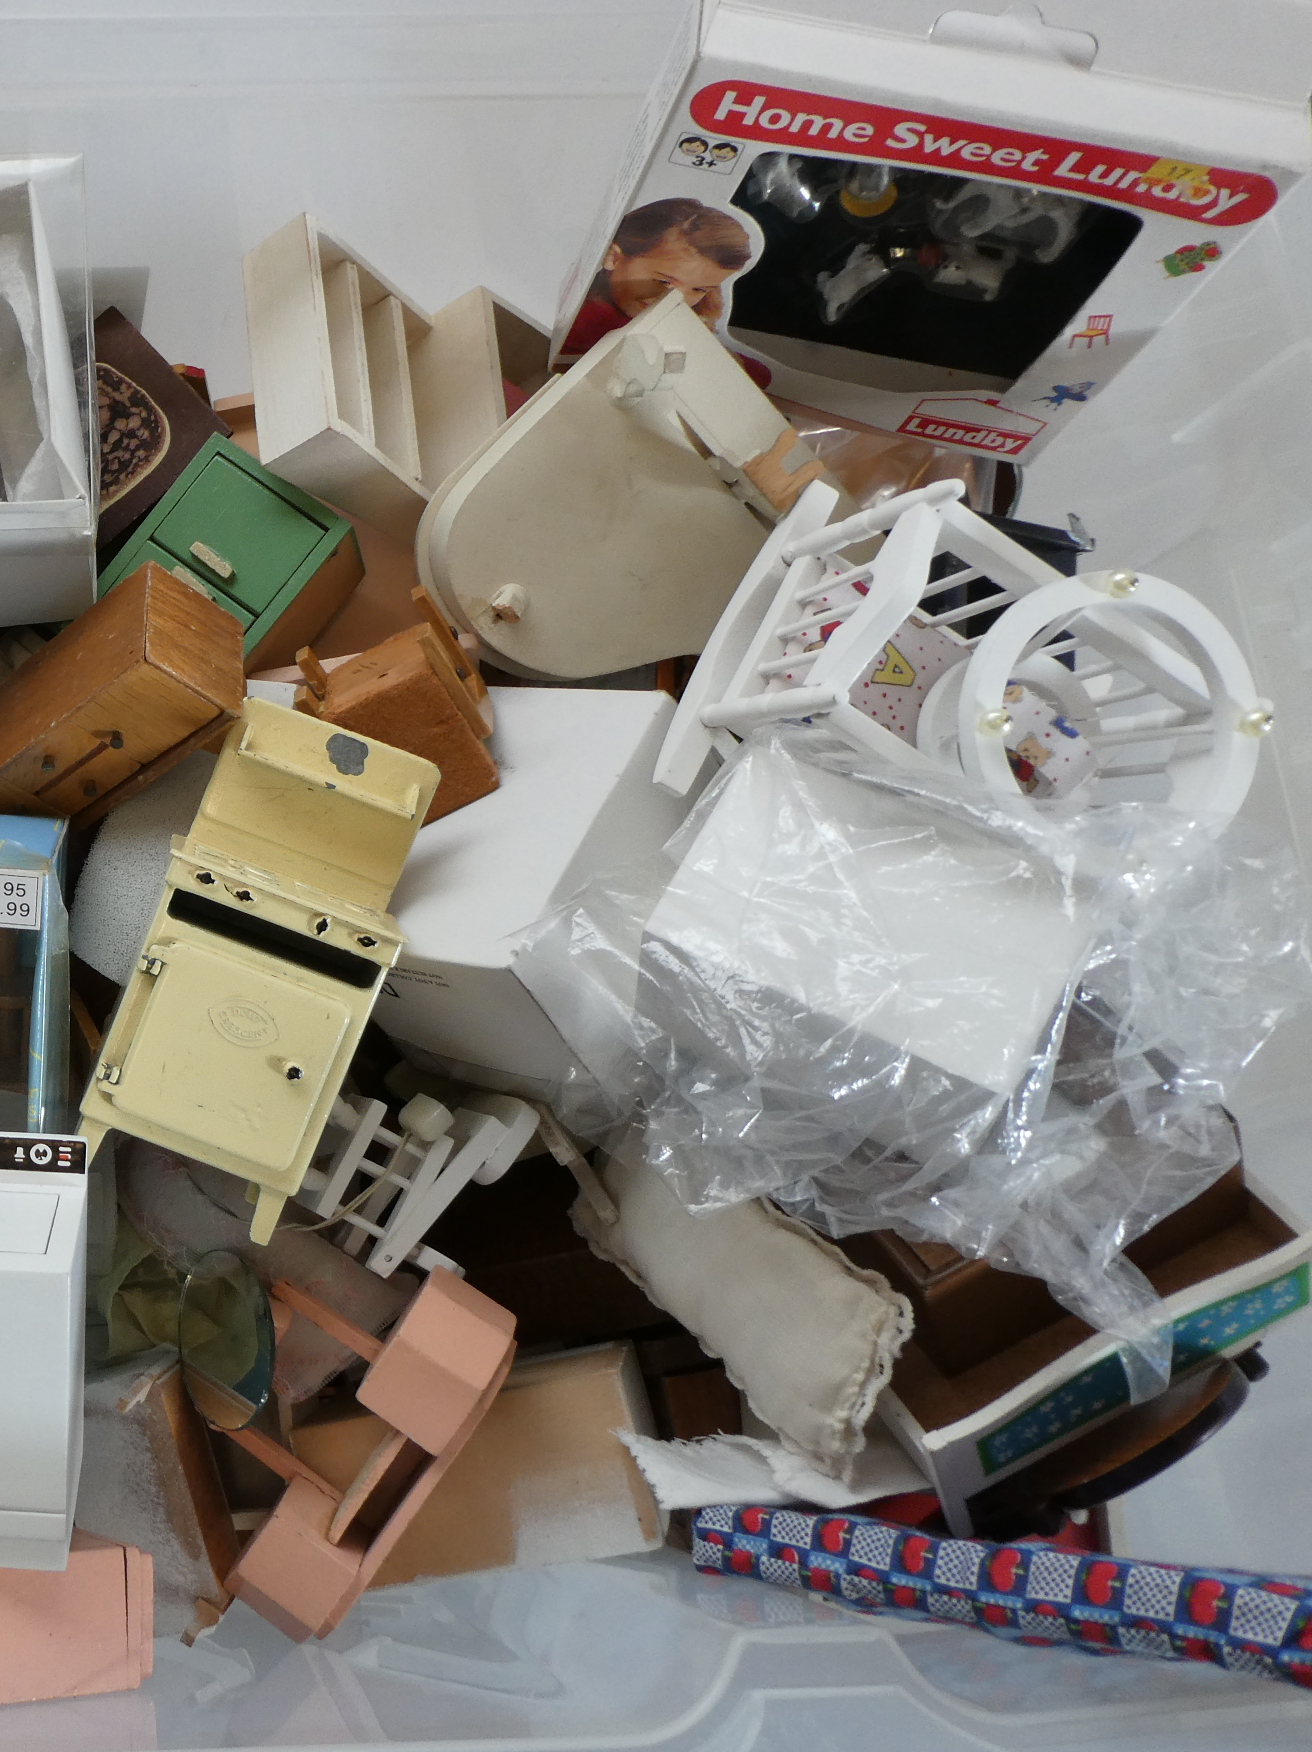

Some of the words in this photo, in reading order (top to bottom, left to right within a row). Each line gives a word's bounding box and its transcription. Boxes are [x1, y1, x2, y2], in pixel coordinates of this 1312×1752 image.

[713, 90, 875, 143] Home
[885, 121, 1049, 172] Sweet
[691, 155, 717, 168] 3+
[905, 418, 1023, 452] Lundby
[870, 640, 916, 687] A
